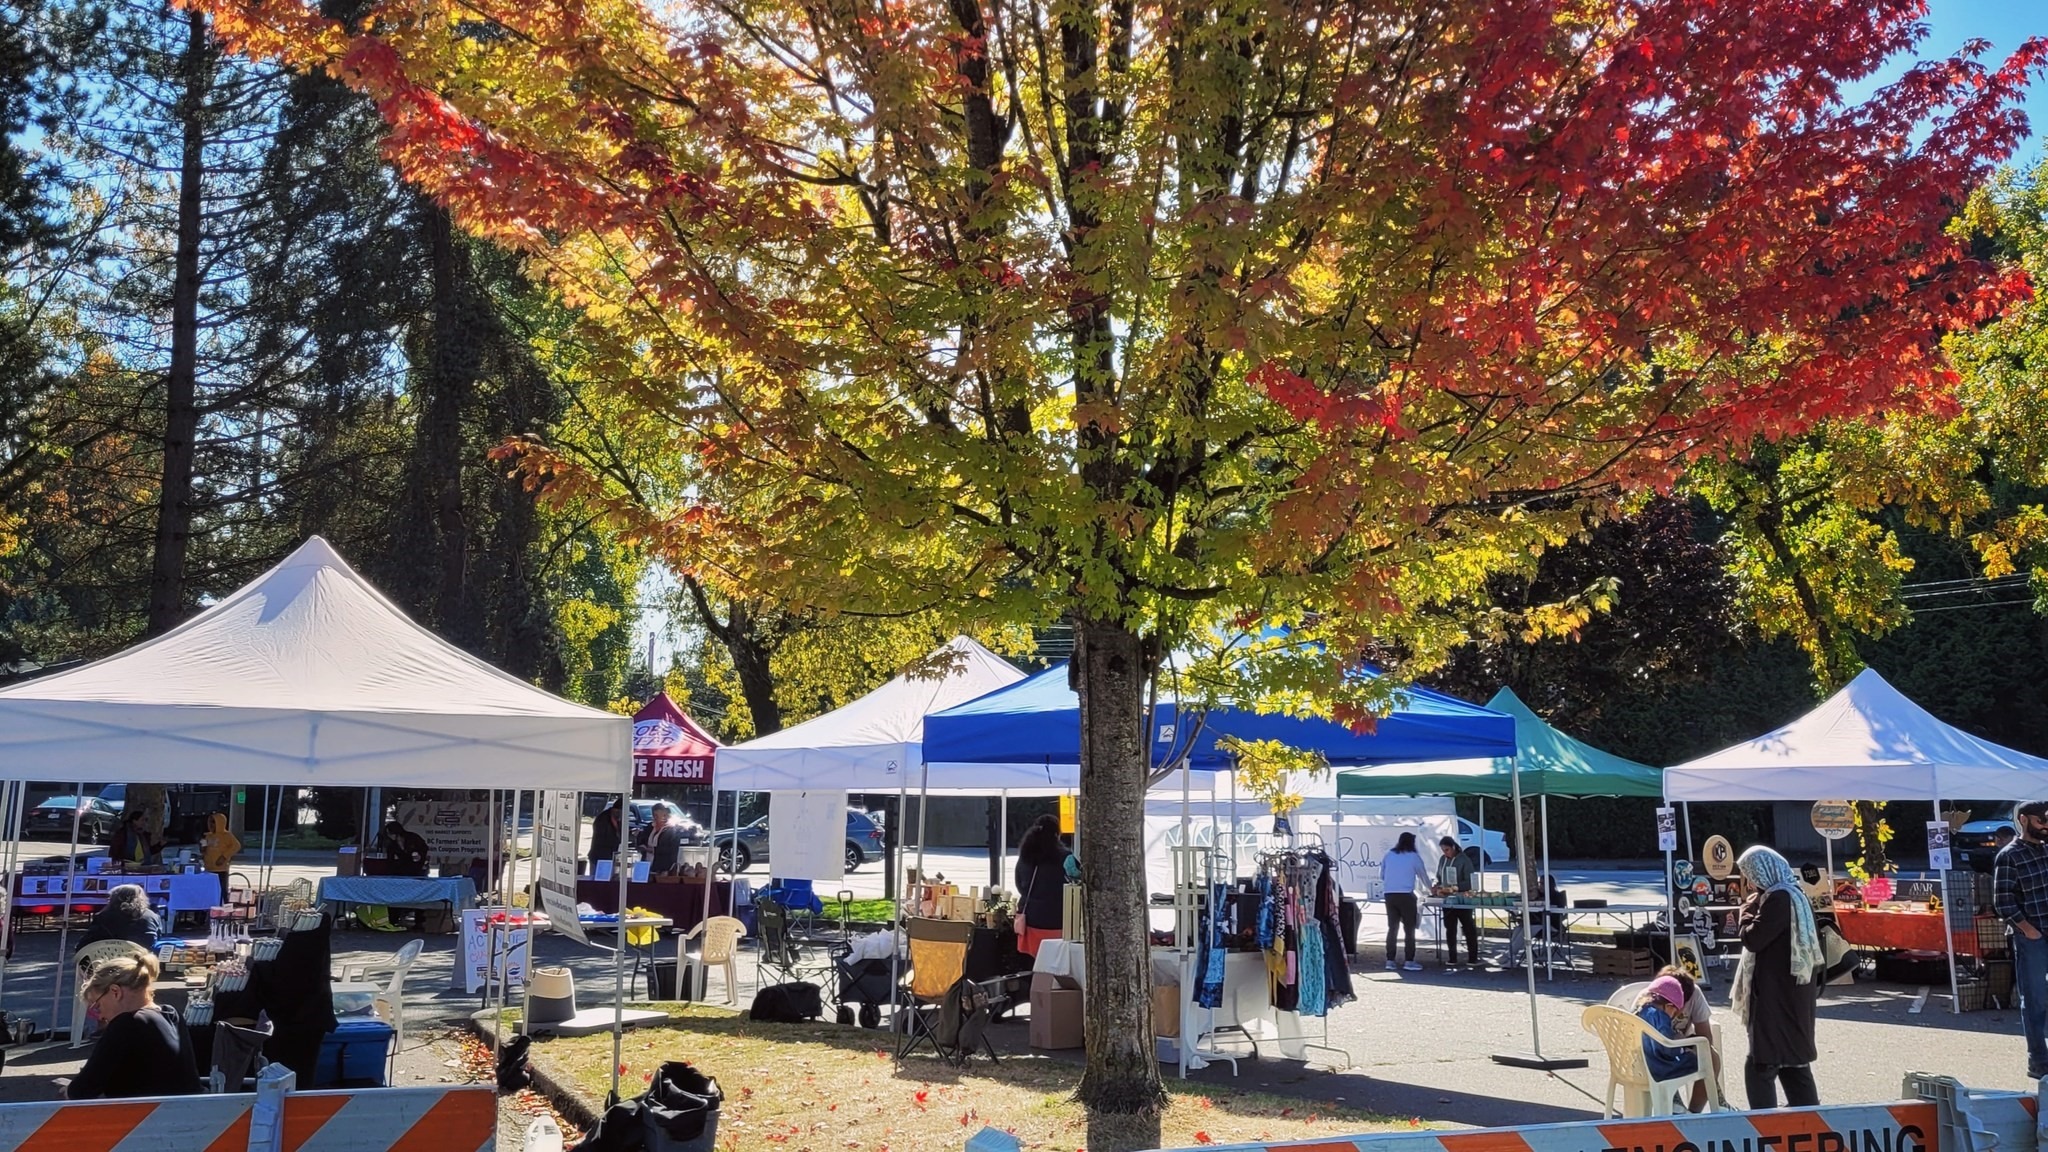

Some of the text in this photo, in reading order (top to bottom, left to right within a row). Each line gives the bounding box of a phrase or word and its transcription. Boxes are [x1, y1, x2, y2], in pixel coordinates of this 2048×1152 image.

[633, 725, 672, 736] OBS
[654, 759, 704, 778] FRESH
[461, 846, 486, 854] Program
[1338, 836, 1382, 883] Radia
